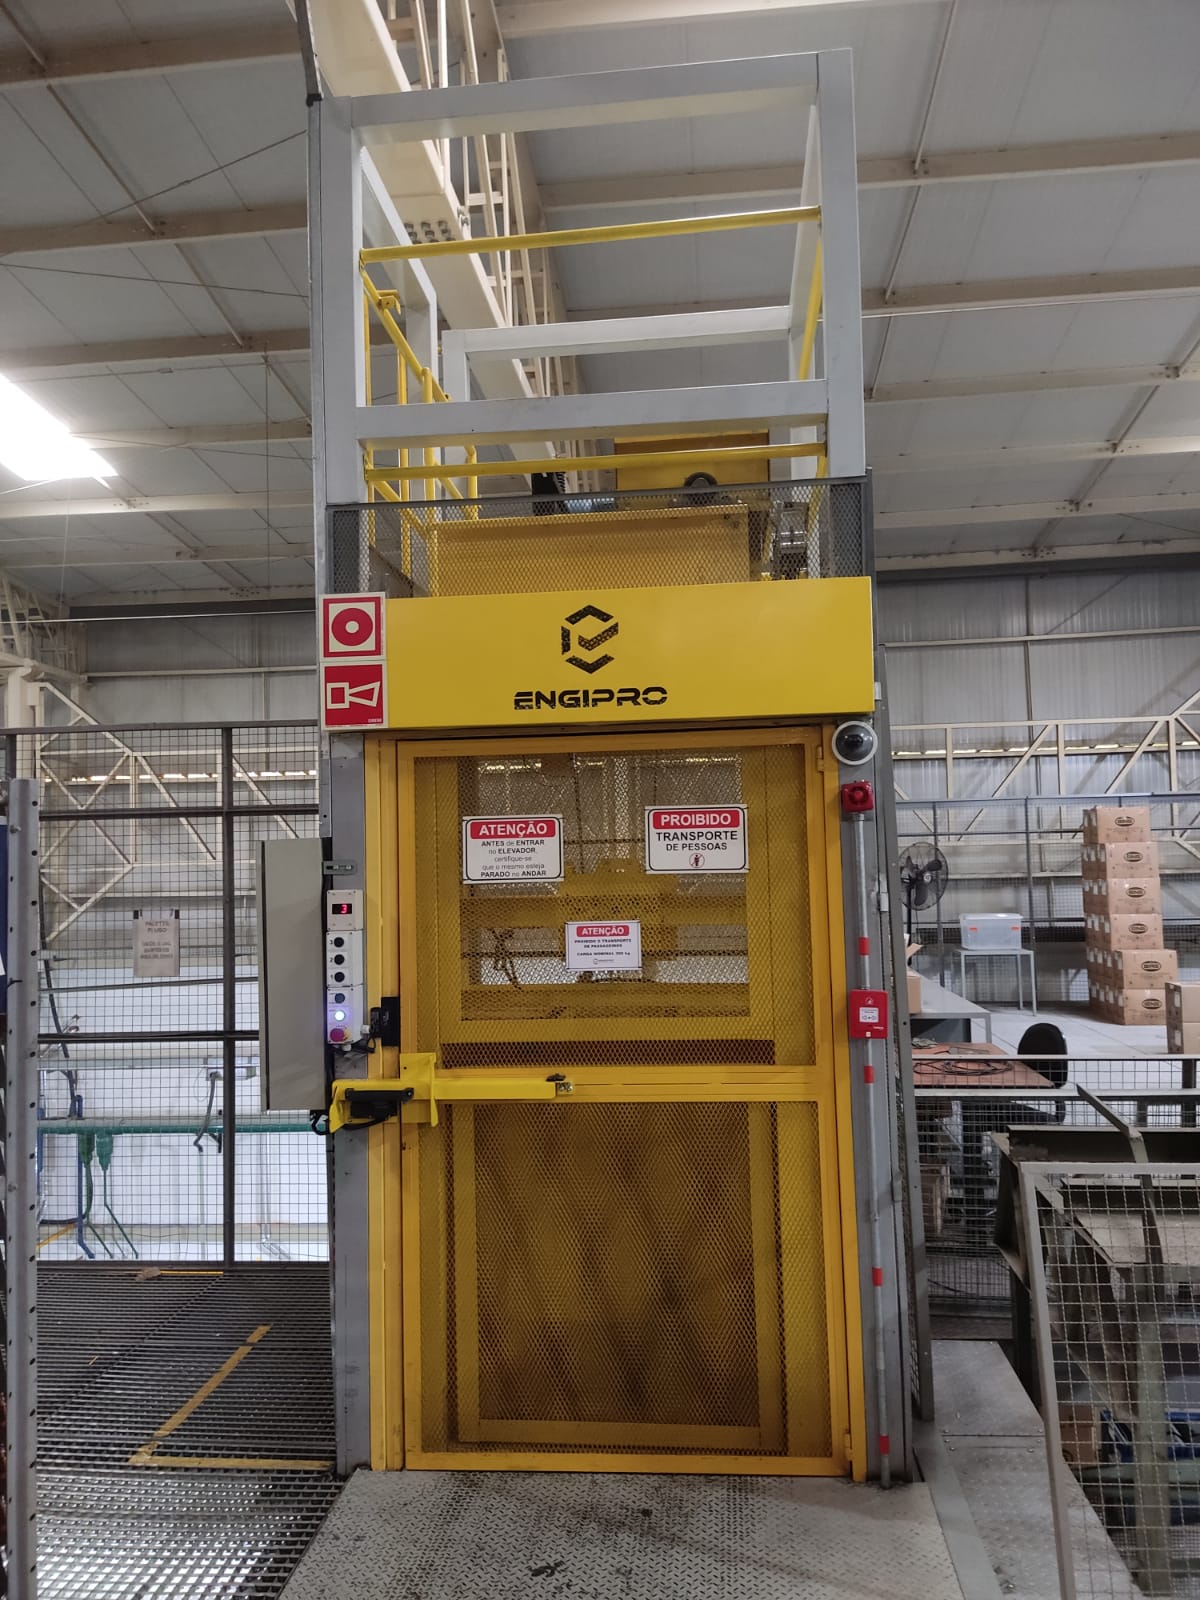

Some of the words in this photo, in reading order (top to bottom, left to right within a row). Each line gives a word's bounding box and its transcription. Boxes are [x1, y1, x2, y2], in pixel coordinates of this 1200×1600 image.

[514, 686, 668, 710] ENGIPRO
[661, 813, 731, 826] PROIBIDO
[479, 821, 547, 838] ATENÇÃO
[656, 831, 738, 841] TRANSPORTE
[666, 843, 679, 851] DE
[682, 842, 728, 851] PESSOAS
[341, 904, 348, 914] 3
[581, 925, 625, 936] ATENÇÃO
